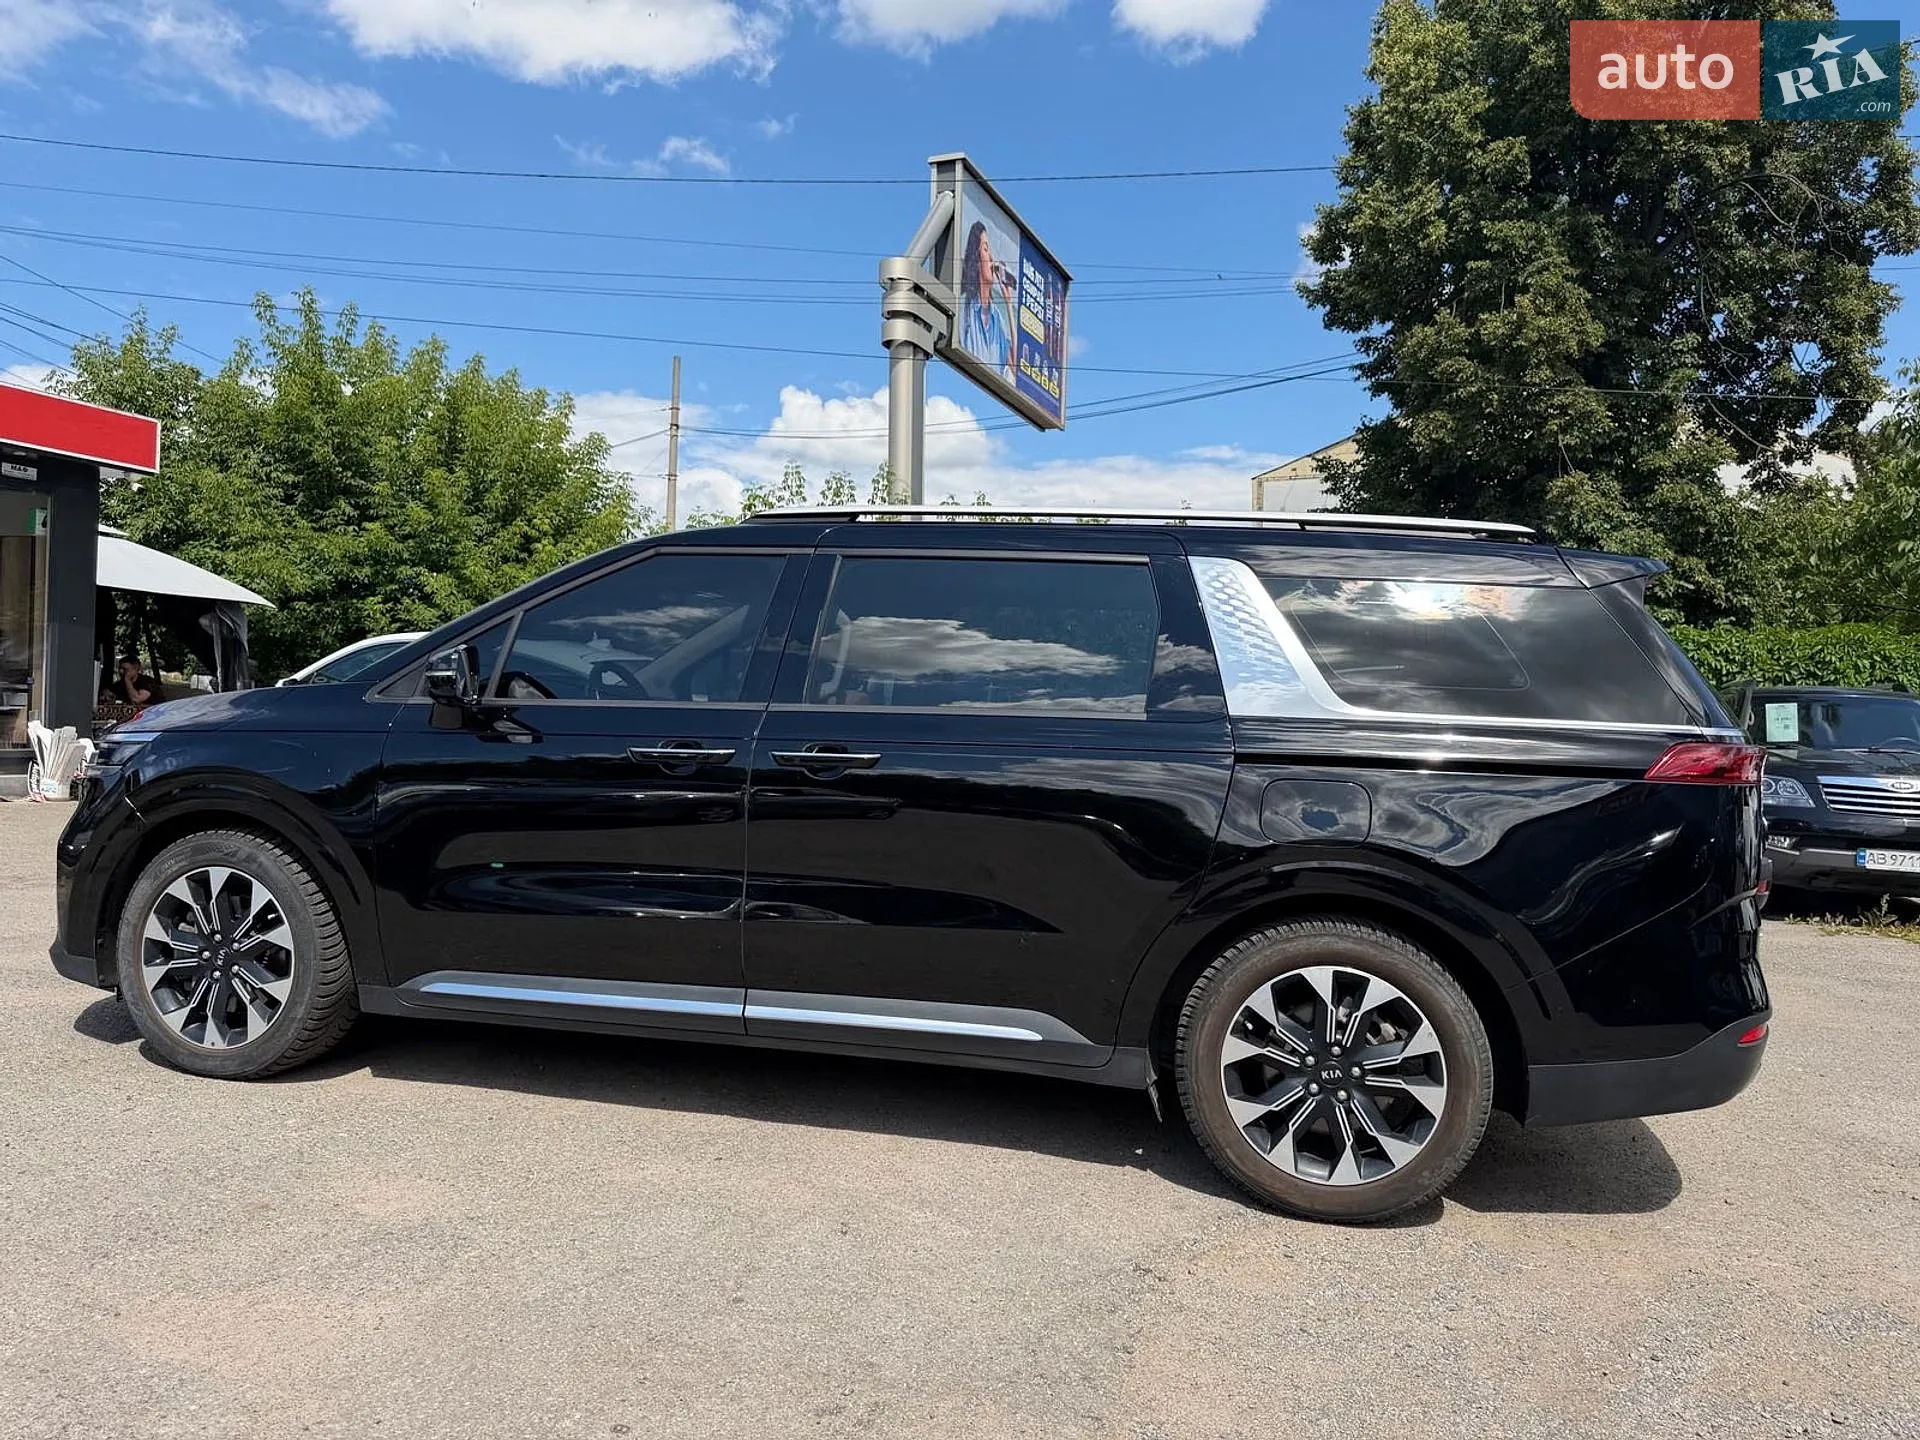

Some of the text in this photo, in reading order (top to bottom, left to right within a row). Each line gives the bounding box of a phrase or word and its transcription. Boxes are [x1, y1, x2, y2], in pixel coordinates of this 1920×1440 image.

[1867, 852, 1887, 865] AB
[217, 949, 226, 966] KIA
[1321, 1069, 1342, 1080] KIA
